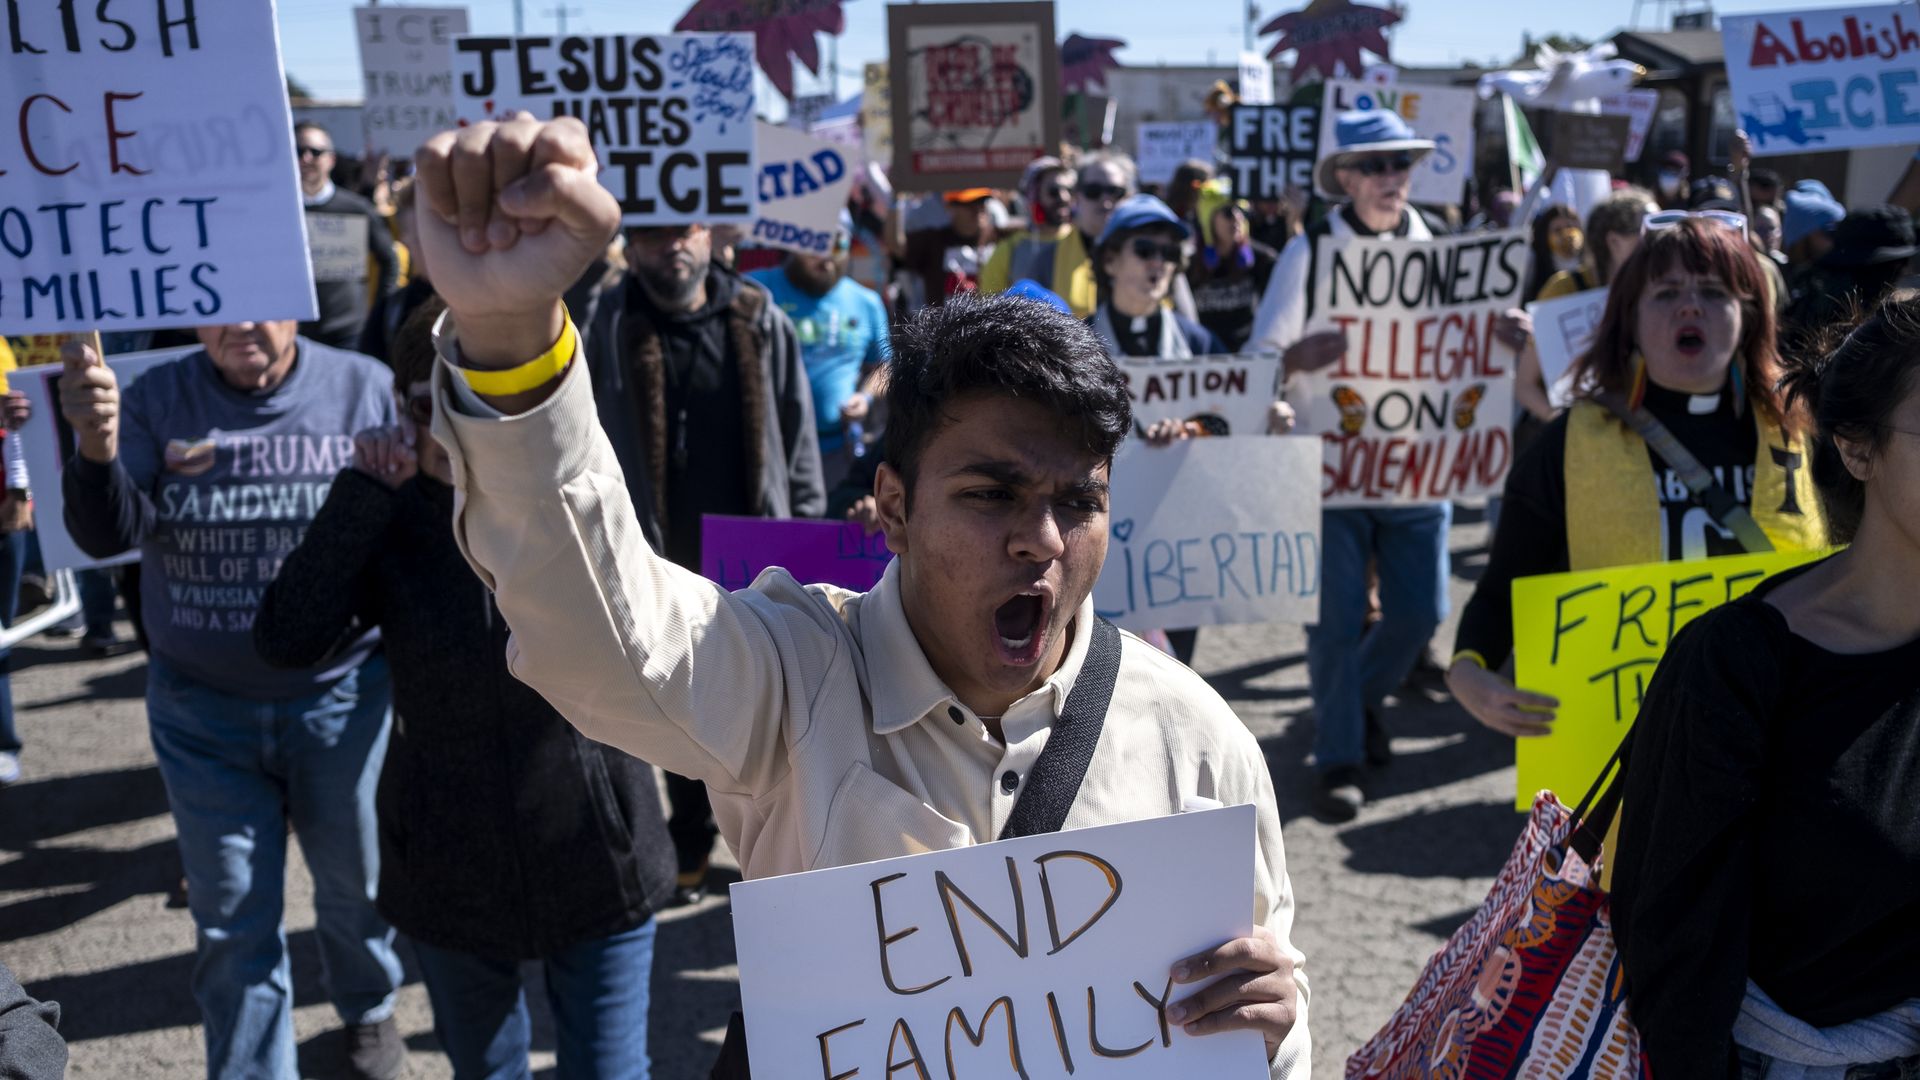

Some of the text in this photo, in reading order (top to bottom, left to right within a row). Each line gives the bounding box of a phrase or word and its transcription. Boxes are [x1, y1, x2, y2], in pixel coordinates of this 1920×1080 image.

[366, 14, 450, 45] ICE
[457, 36, 664, 96] JESUS
[1335, 86, 1421, 120] LOVE
[1790, 70, 1920, 129] ICE
[0, 91, 152, 177] CE
[609, 151, 750, 215] ICE
[1230, 156, 1314, 198] THE
[0, 262, 222, 321] MILIES
[1327, 310, 1504, 382] ILLEGAL
[1372, 390, 1449, 431] ON
[226, 433, 355, 478] TRUMP
[163, 554, 214, 582] FULL
[219, 557, 250, 582] OF
[171, 606, 204, 630] AND
[208, 610, 223, 631] A
[869, 849, 1123, 996] END
[816, 975, 1174, 1080] FAMILY
